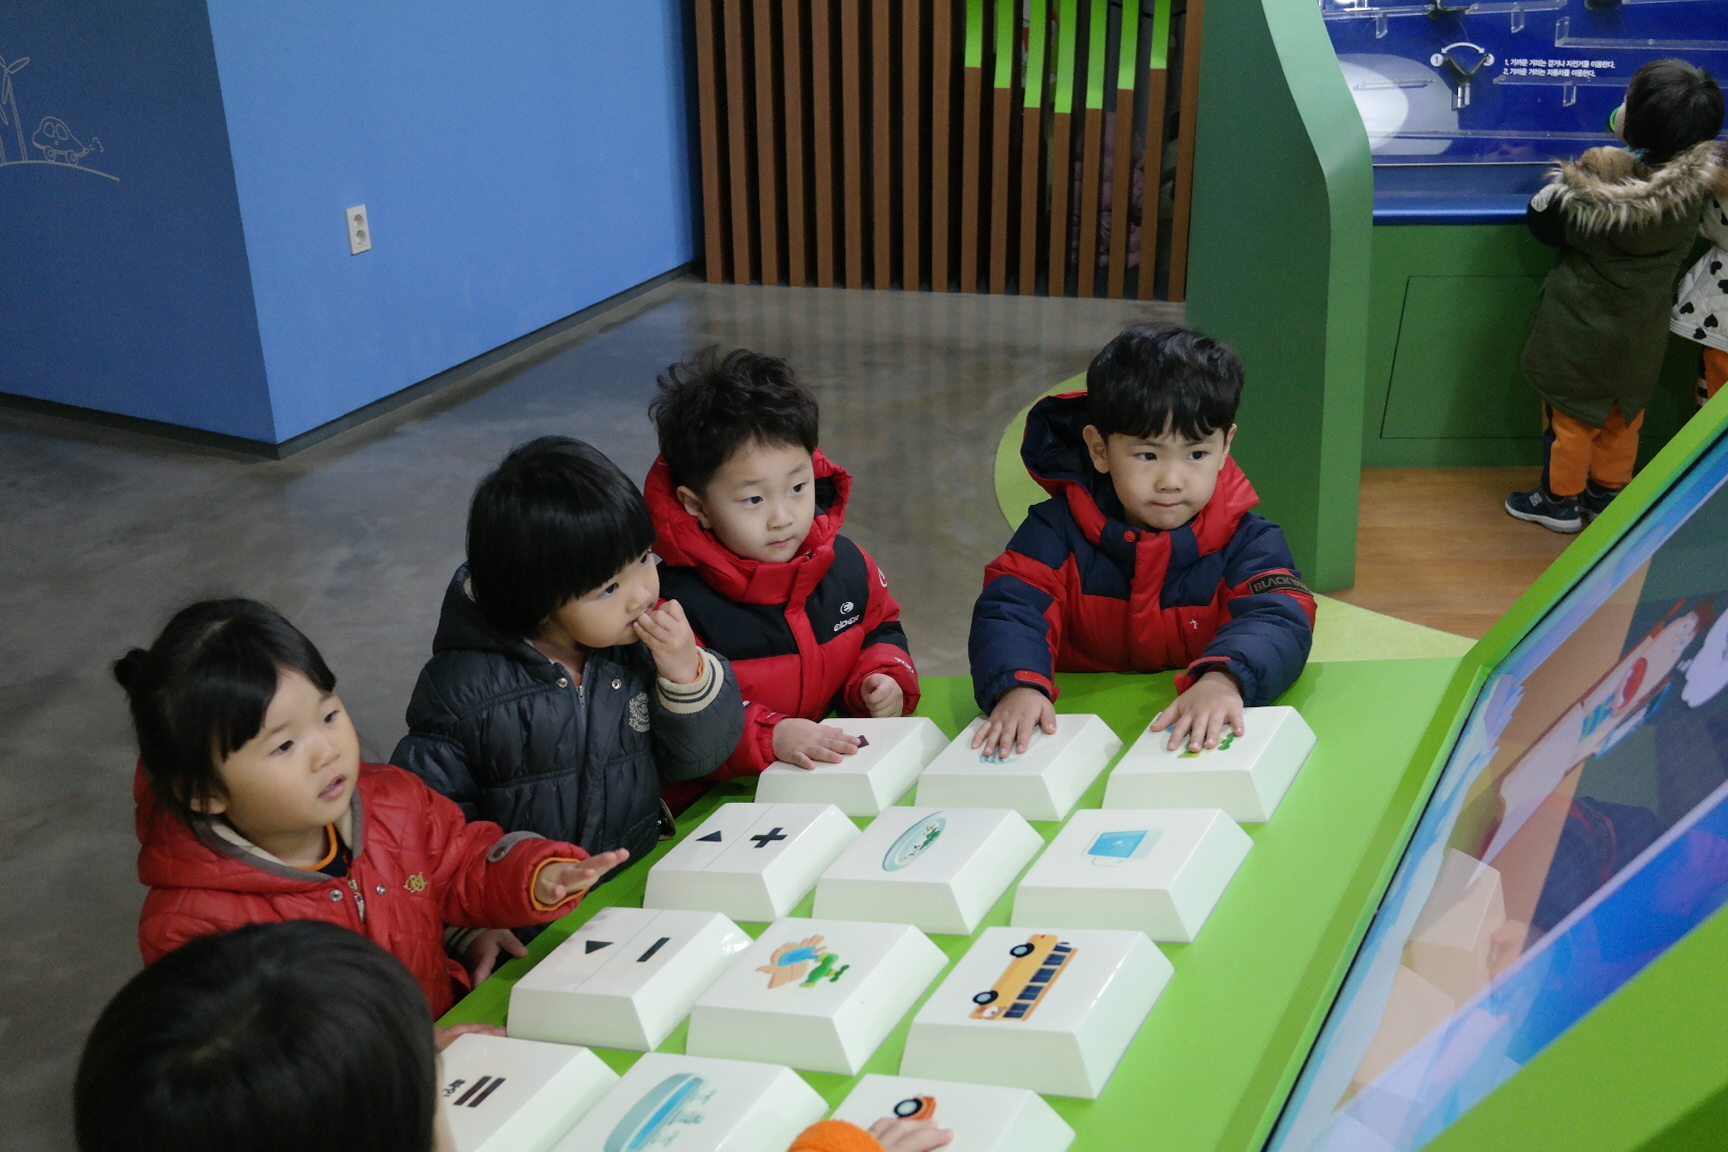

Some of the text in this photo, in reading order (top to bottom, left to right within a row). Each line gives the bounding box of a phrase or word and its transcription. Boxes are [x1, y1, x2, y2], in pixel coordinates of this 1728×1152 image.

[1529, 59, 1547, 67] 거리는
[1566, 60, 1589, 68] 자전거를
[1528, 68, 1546, 77] 거리는
